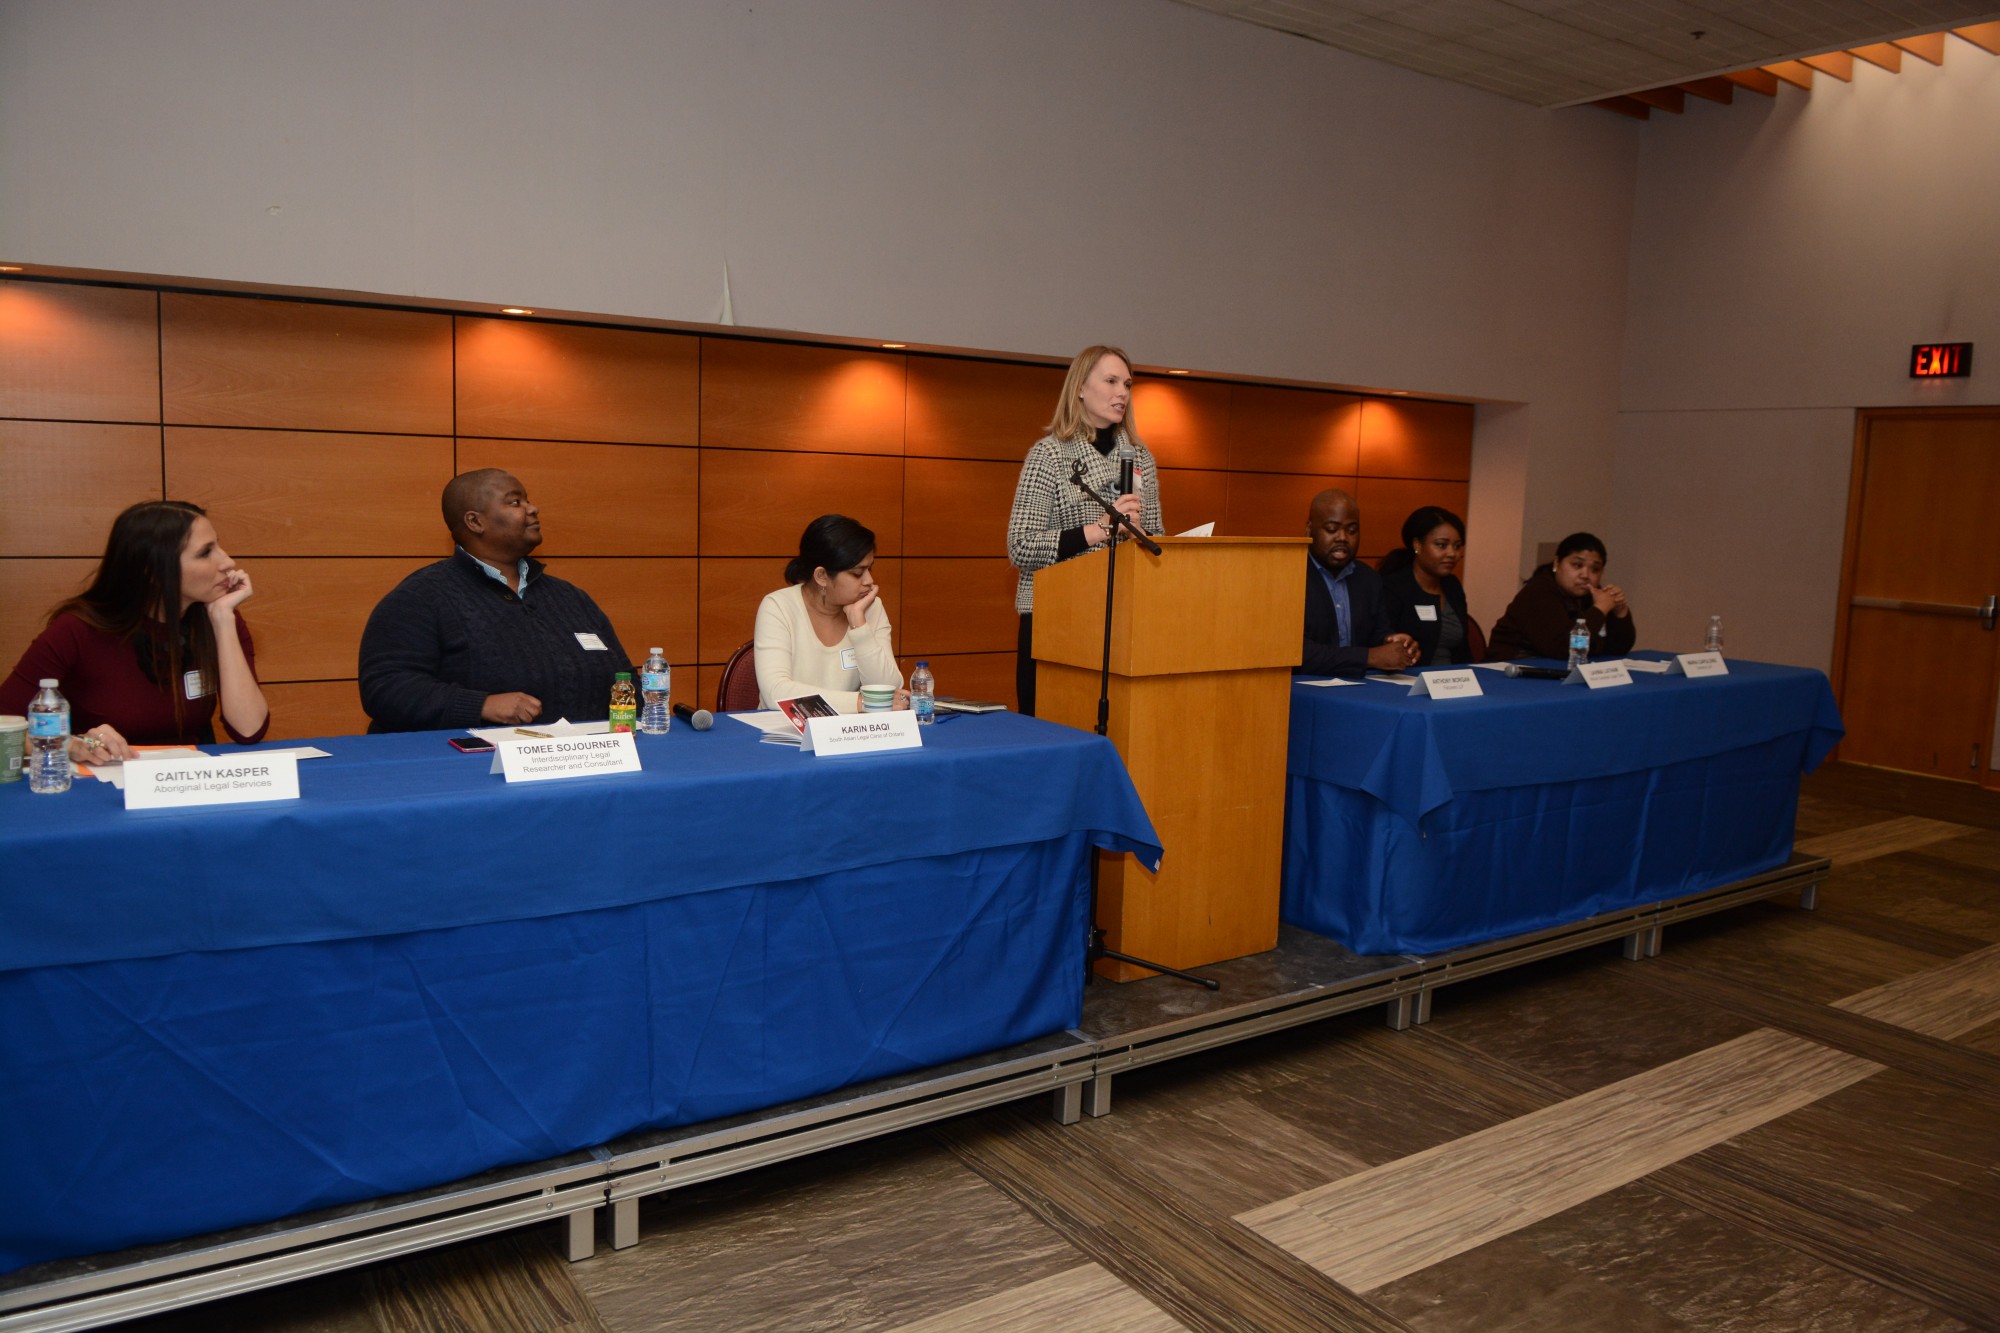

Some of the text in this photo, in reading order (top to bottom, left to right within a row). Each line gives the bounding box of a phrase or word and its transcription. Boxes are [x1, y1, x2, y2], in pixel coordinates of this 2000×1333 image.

[1915, 346, 1962, 375] EXIT
[841, 723, 890, 734] KARIN BAQI
[857, 734, 870, 742] Legal
[517, 739, 621, 755] TOMEE SOJOURNER
[531, 750, 611, 764] Interdisciplinary Legal
[523, 758, 623, 774] Researcher and Consultant
[155, 766, 269, 782] CAITLYN KASPER
[154, 779, 272, 794] Aboriginal Legal Services
